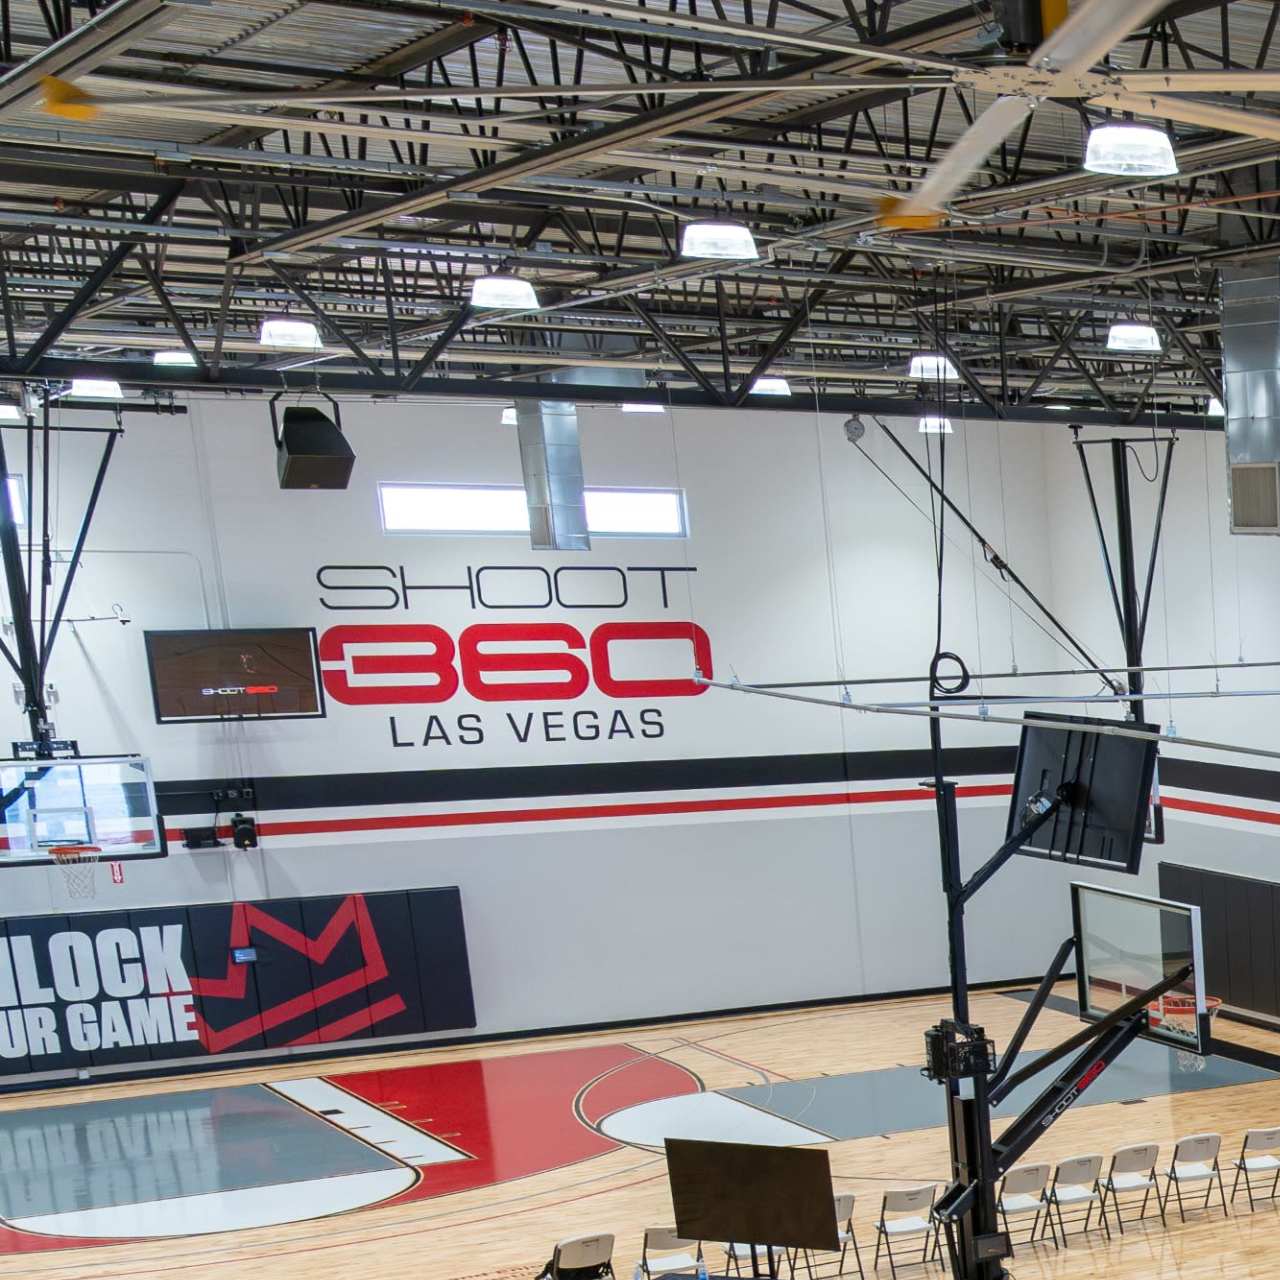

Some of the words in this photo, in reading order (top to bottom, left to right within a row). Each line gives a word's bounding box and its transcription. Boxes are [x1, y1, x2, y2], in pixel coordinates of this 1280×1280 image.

[316, 565, 697, 610] SHOOT
[319, 621, 713, 705] 360
[389, 713, 485, 748] LAS
[506, 708, 665, 743] VEGAS
[65, 993, 200, 1052] GAME
